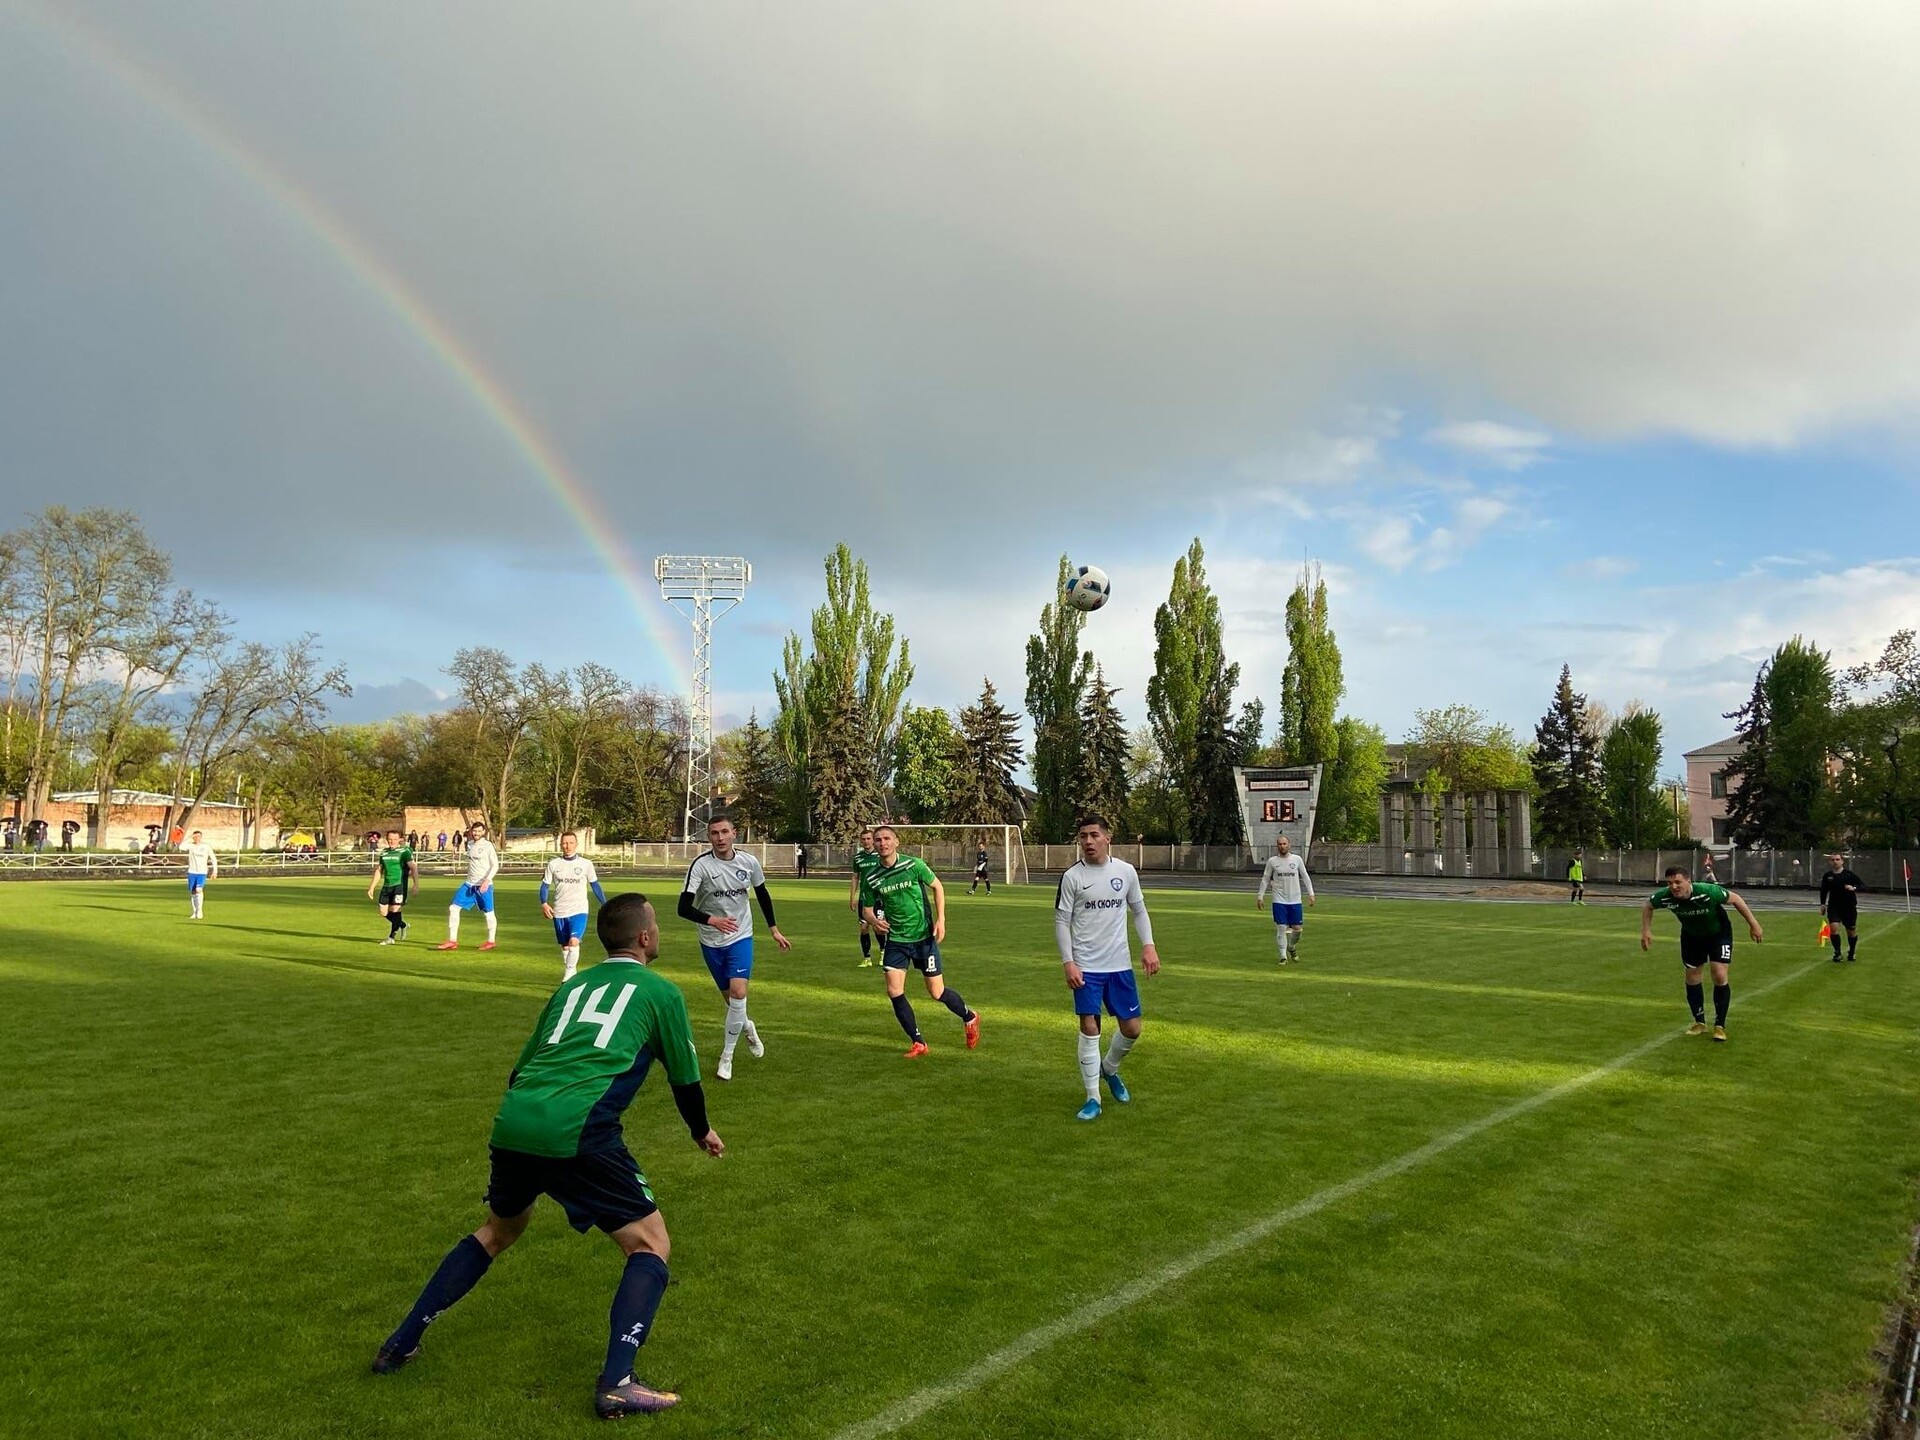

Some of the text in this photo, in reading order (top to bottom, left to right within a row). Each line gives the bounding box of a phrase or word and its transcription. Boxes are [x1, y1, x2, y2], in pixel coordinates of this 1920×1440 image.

[1084, 900, 1096, 909] ФК
[1721, 944, 1731, 957] 15
[927, 955, 936, 969] 8
[547, 982, 637, 1049] 14
[620, 1333, 640, 1347] ZEUS
